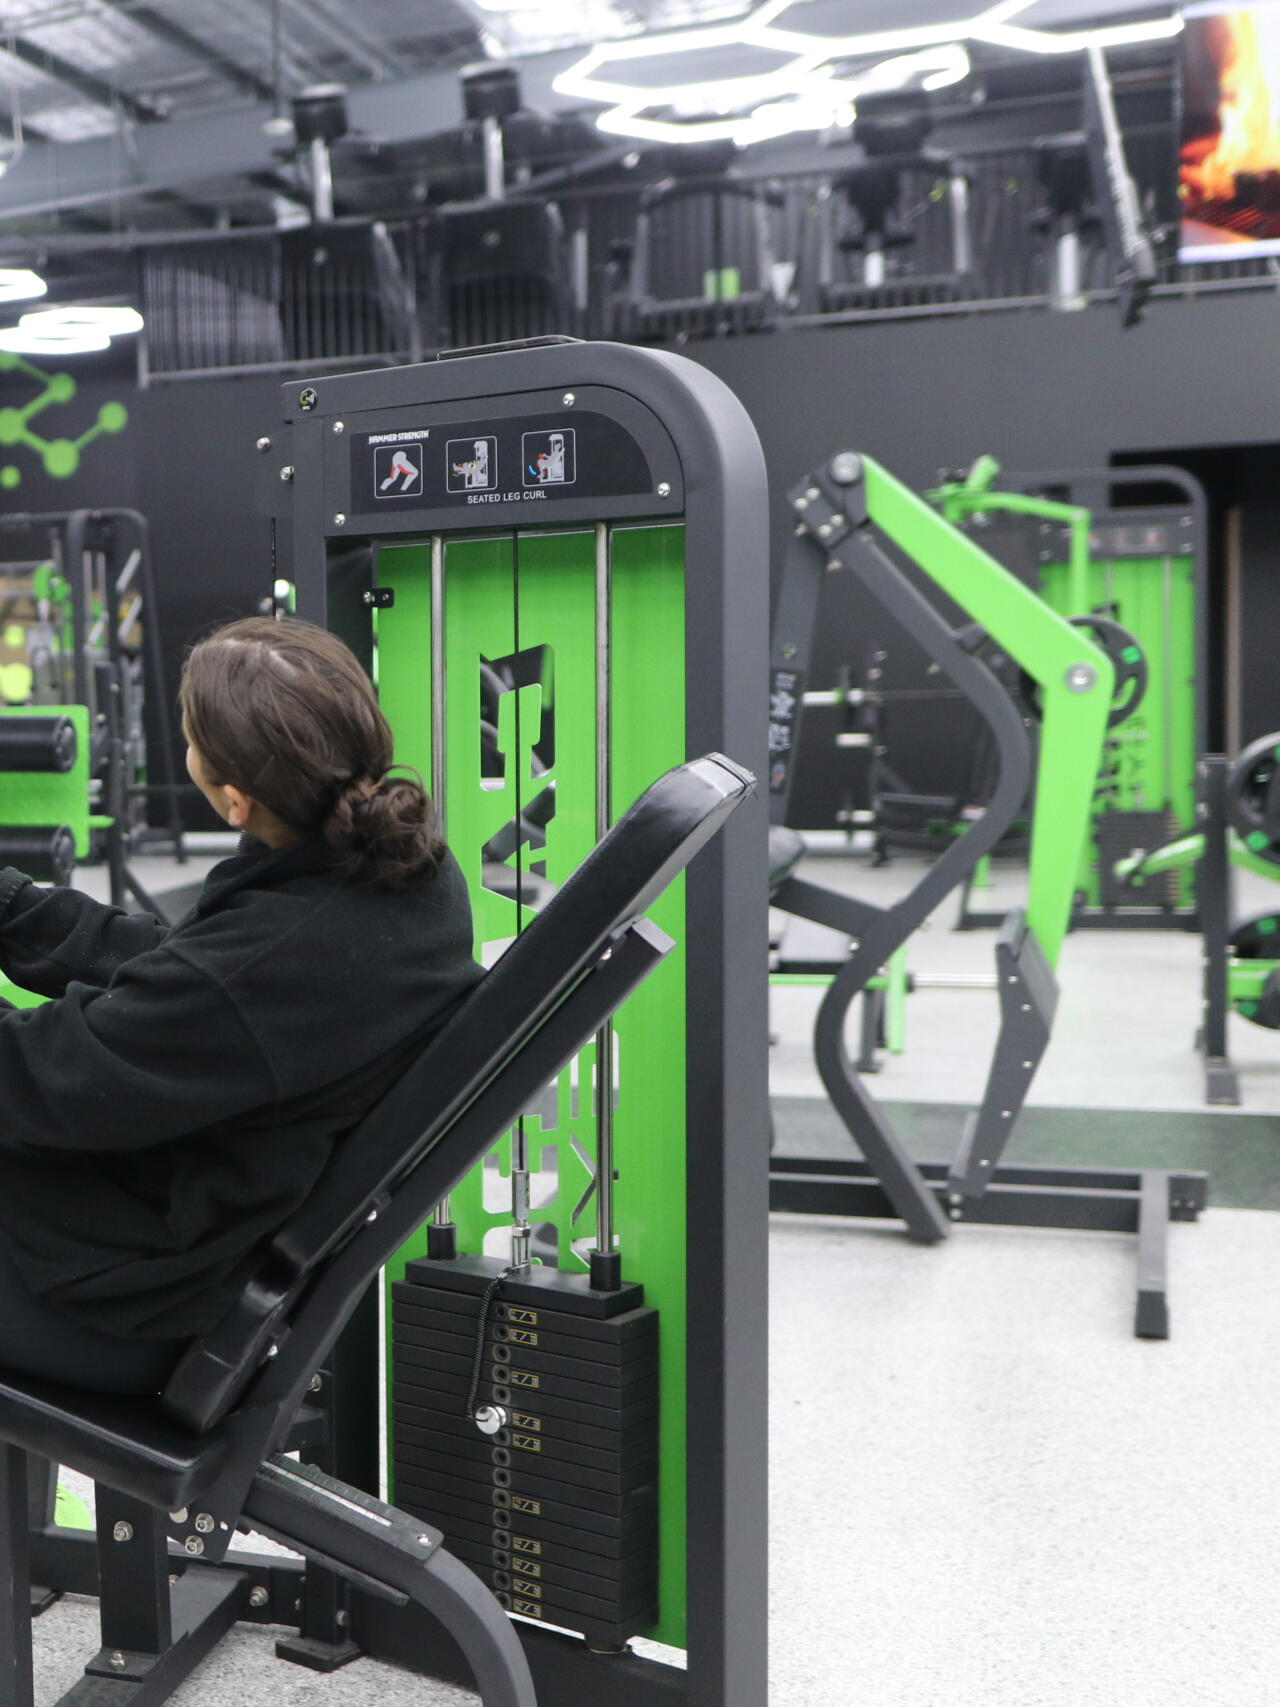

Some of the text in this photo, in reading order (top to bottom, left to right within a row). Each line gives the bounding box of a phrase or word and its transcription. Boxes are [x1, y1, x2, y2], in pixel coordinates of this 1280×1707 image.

[398, 429, 430, 441] STRENGTH
[467, 490, 548, 505] SEATED LEG CURL
